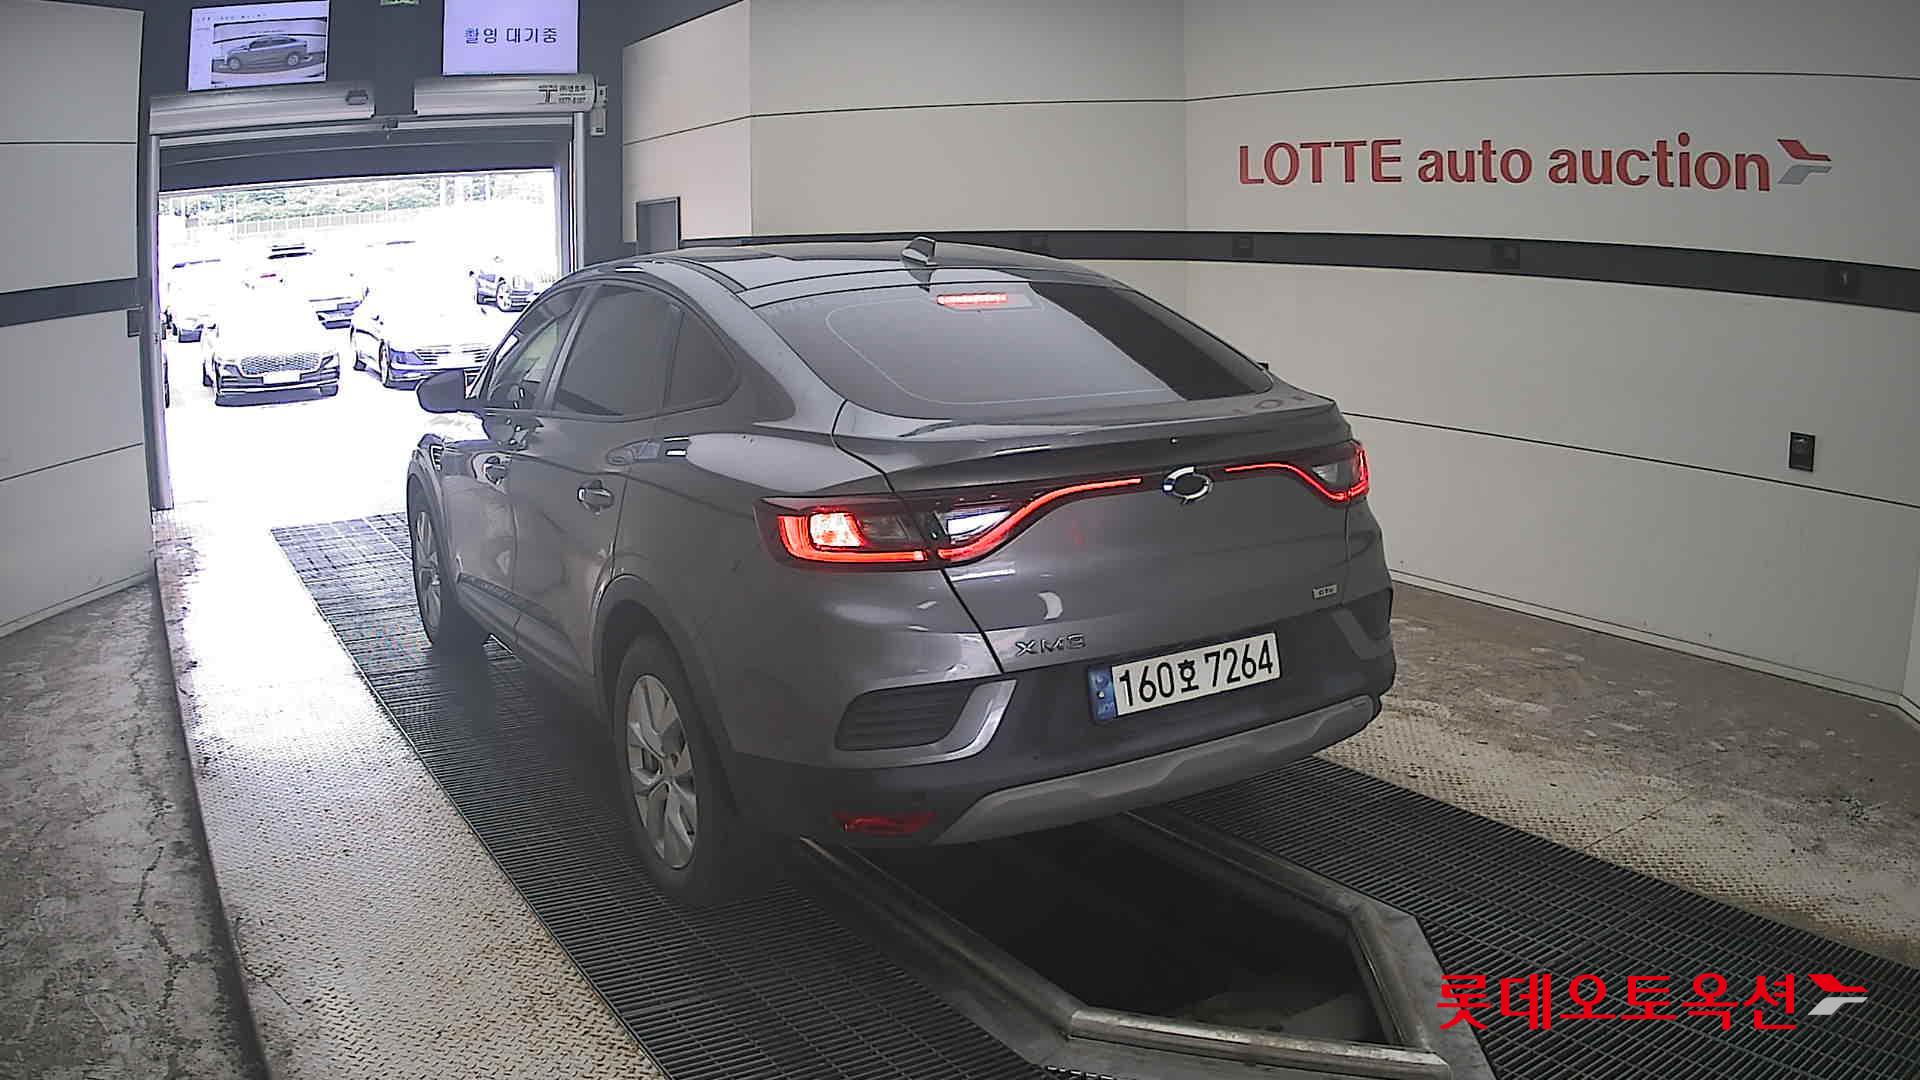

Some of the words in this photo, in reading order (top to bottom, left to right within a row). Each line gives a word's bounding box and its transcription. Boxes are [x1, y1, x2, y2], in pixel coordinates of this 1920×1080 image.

[506, 27, 558, 44] 대기중
[1239, 138, 1402, 185] LOTTE
[1417, 139, 1533, 185] auto
[1548, 131, 1771, 192] auction
[1014, 633, 1087, 657] XM3
[1119, 659, 1200, 707] 160호
[1203, 639, 1274, 687] 7264
